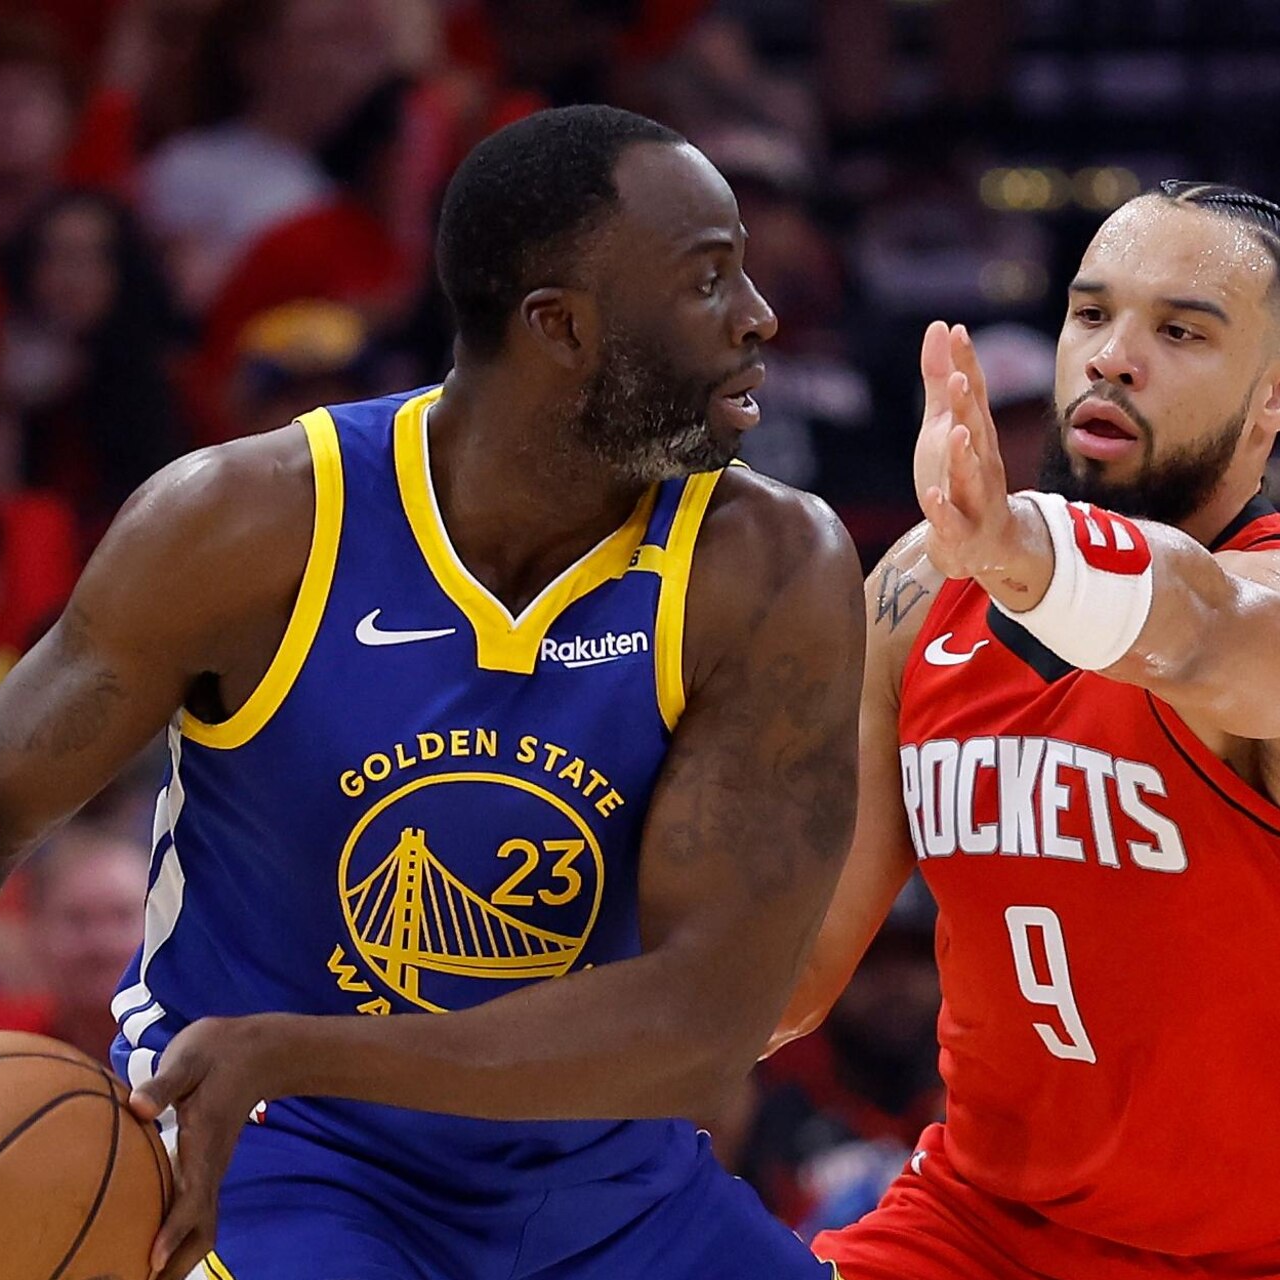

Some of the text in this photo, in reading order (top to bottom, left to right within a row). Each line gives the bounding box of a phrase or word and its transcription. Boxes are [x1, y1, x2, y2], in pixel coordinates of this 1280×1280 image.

[541, 631, 648, 662] Rakuten
[340, 728, 624, 818] GOLDEN STATE
[899, 736, 1188, 873] ROCKETS
[491, 838, 585, 906] 23
[1005, 905, 1097, 1063] 9
